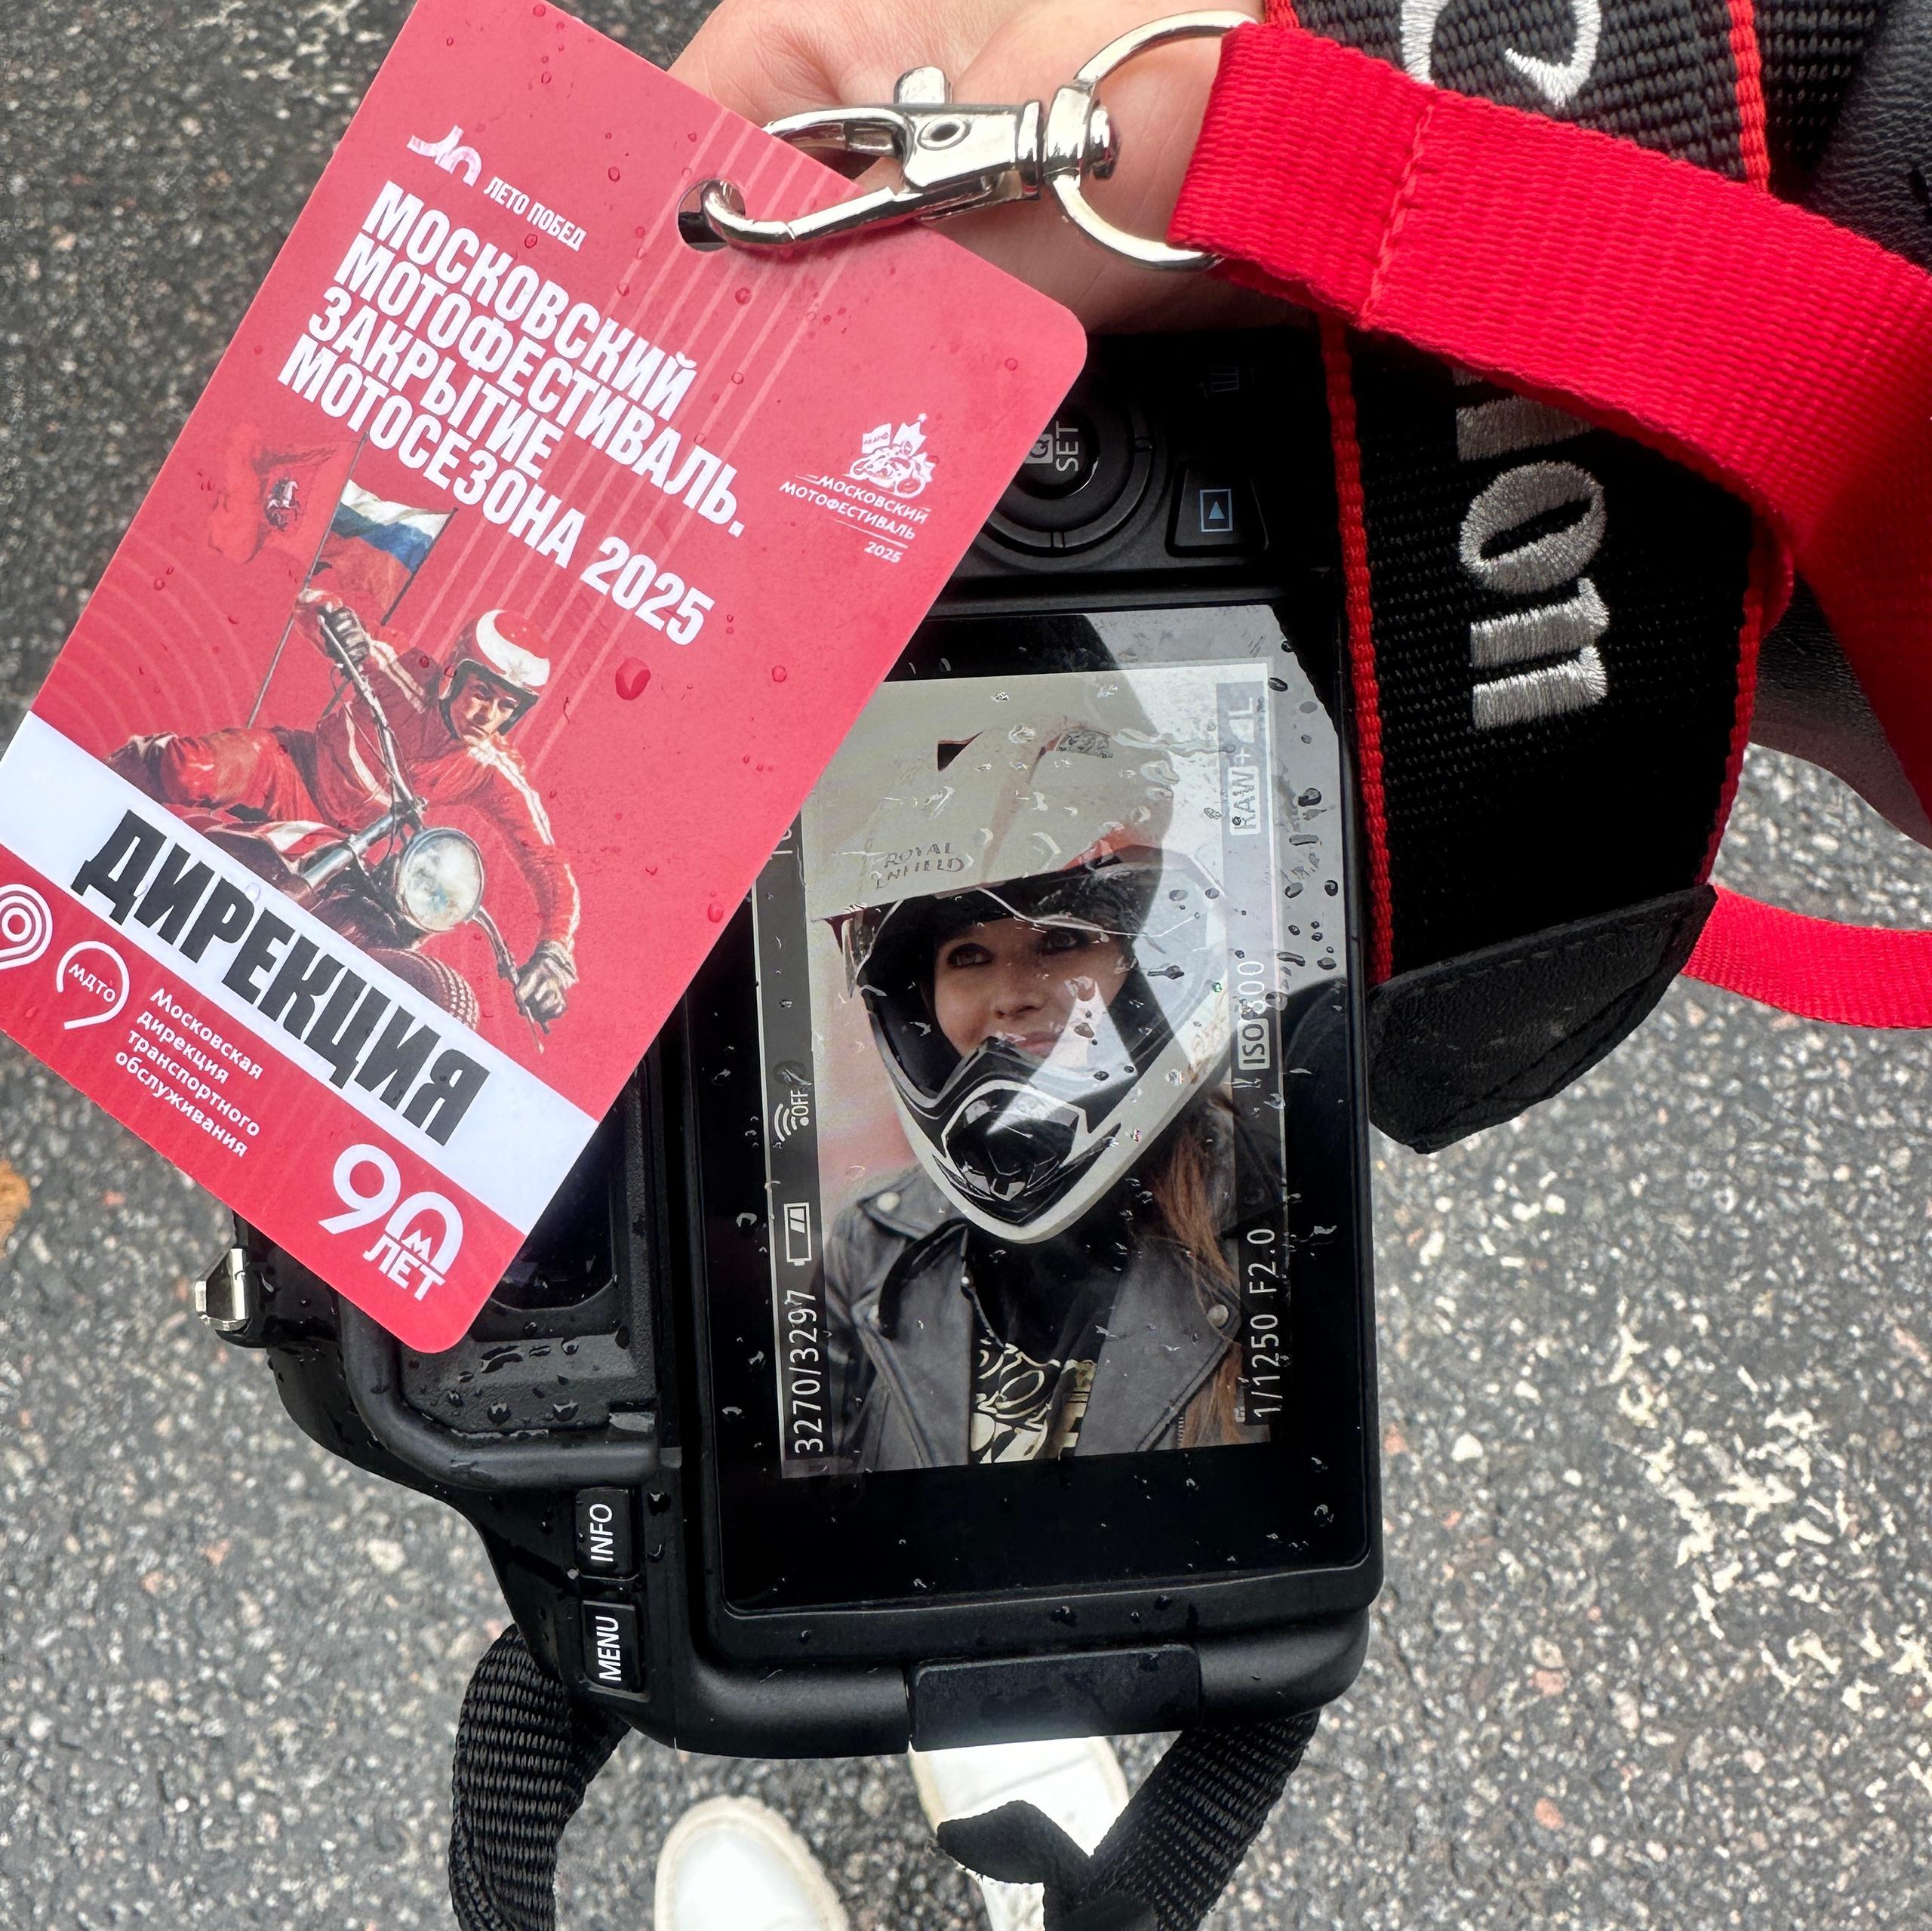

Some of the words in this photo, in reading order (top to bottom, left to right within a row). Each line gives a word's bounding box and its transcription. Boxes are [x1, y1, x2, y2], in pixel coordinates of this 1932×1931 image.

[483, 176, 530, 215] ЛЕТО
[526, 201, 586, 252] ПОБЕД
[362, 180, 697, 421] МОСКОВСКИЙ
[309, 286, 565, 480] ЗАКРЫТИЕ
[334, 232, 745, 537] МОТОФЕСТИВАЛЬ.
[1055, 420, 1078, 472] SET
[277, 334, 586, 569] МОТОСЕЗОНА
[580, 537, 715, 645] 2025
[779, 481, 915, 540] МОТОФЕСТИВАЛЬ
[817, 475, 931, 524] МОСКОВСКИЙ
[864, 541, 903, 563] 2025
[68, 963, 116, 1002] МДТО
[71, 810, 491, 1146] ДИРЕКЦИЯ
[136, 1010, 229, 1084] дирекция
[150, 988, 263, 1080] Московская
[1241, 1023, 1265, 1064] ISO
[115, 1051, 248, 1158] обслуживания
[128, 1030, 260, 1137] транспортного
[791, 1090, 808, 1116] OFF
[362, 1234, 446, 1302] ЛЕТ
[1247, 1228, 1277, 1294] F2.0
[787, 1289, 824, 1454] 3270/3297
[1250, 1314, 1283, 1418] 1/1250
[589, 1503, 614, 1564] INFO
[595, 1616, 622, 1683] MENU
